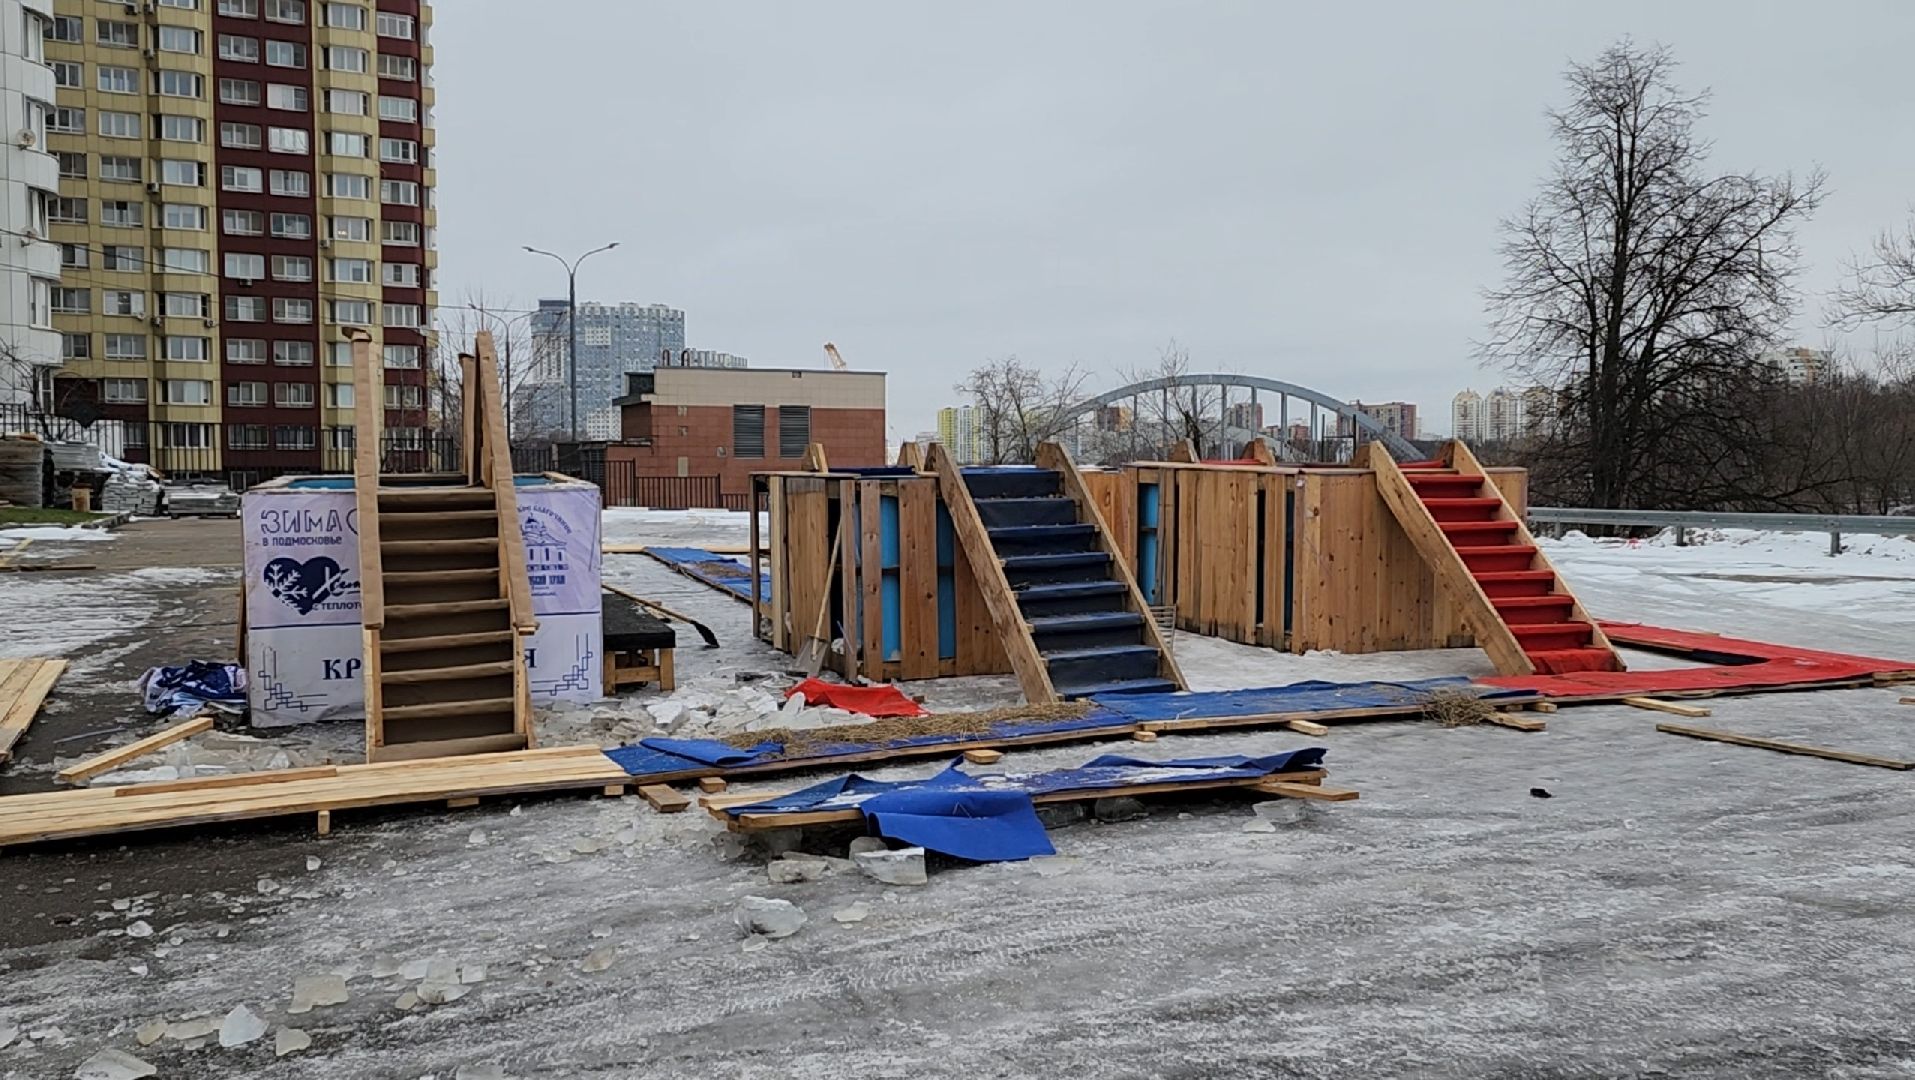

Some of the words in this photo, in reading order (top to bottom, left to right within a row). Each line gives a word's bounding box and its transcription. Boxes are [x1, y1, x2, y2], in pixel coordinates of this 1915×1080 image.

[261, 509, 343, 534] ЗИМА
[321, 602, 362, 611] ТЕПЛОТ
[322, 658, 362, 680] КР
